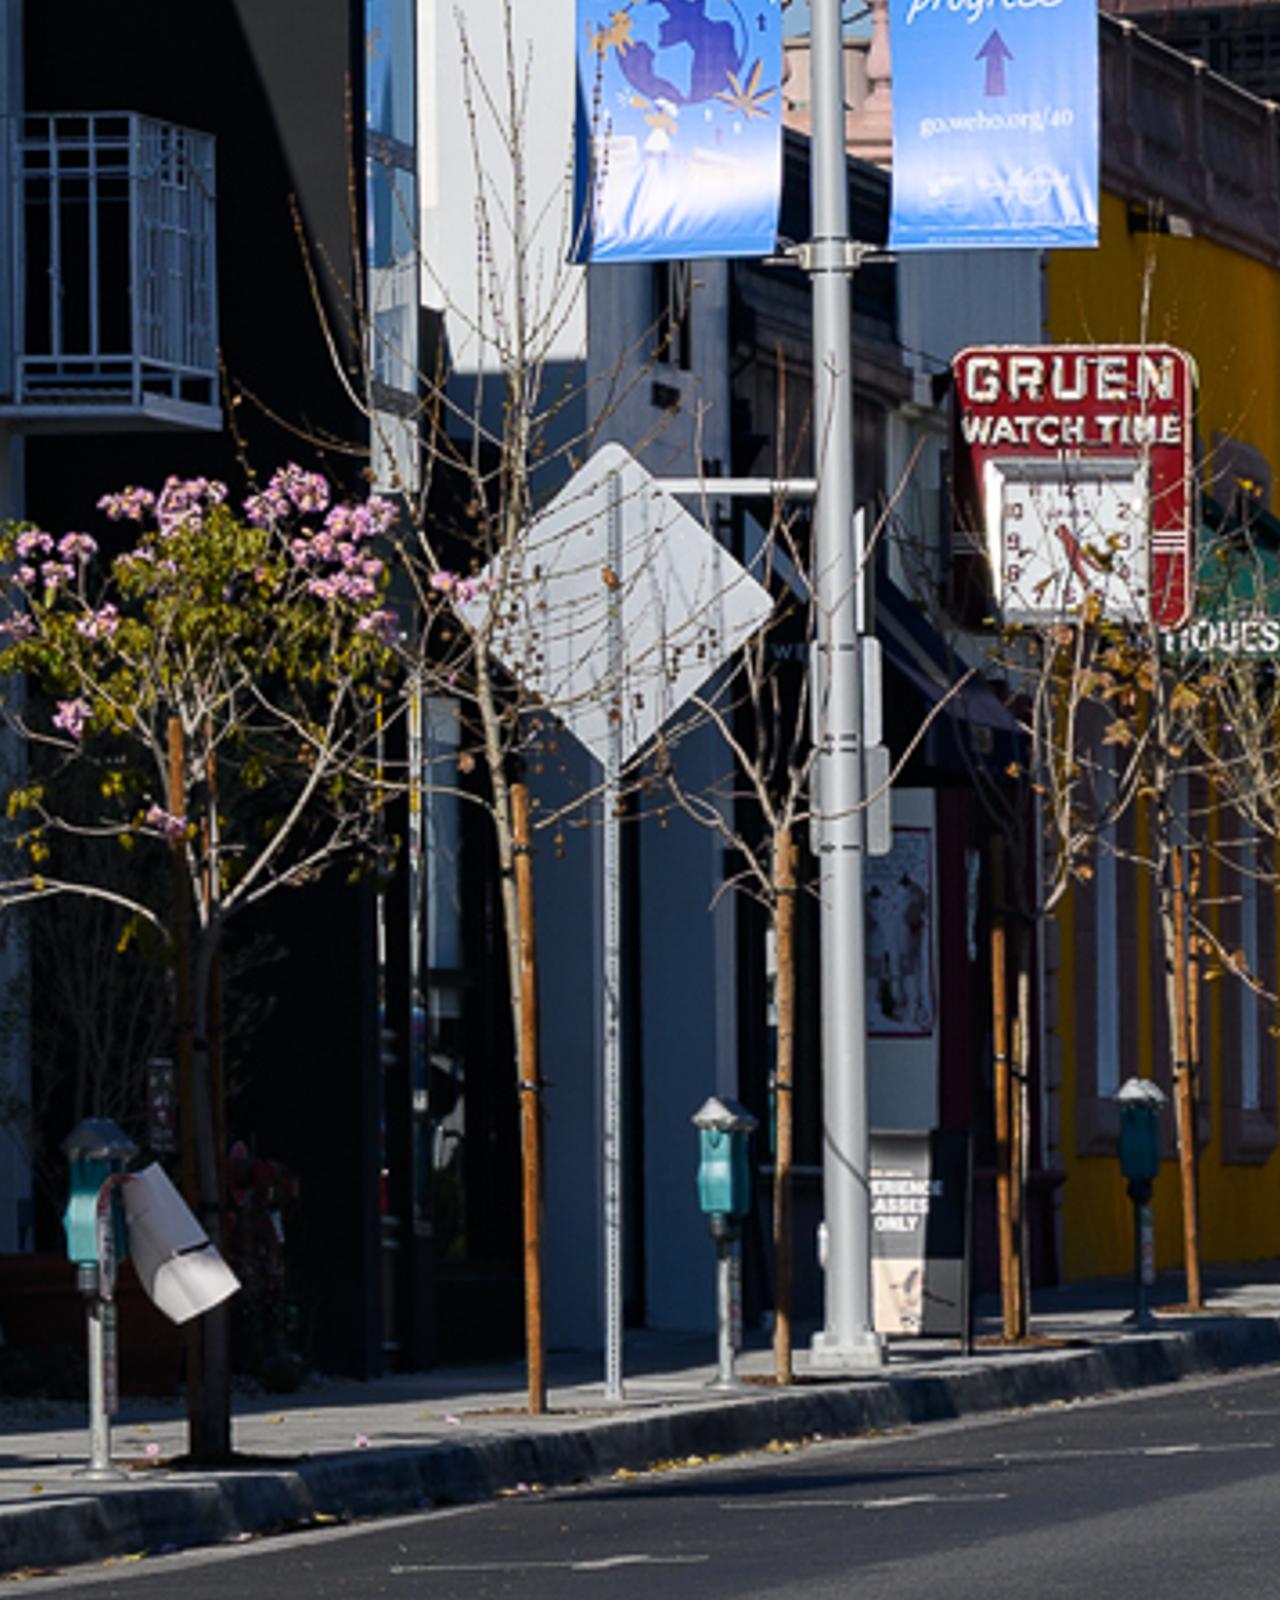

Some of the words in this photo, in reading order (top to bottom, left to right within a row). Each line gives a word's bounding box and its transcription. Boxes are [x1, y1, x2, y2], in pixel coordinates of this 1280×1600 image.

[920, 106, 1074, 138] go.weho.org/40
[964, 356, 1175, 402] GRUEN
[961, 413, 1084, 446] WATCH
[1097, 414, 1182, 446] TIME
[874, 1216, 918, 1232] ONLY
